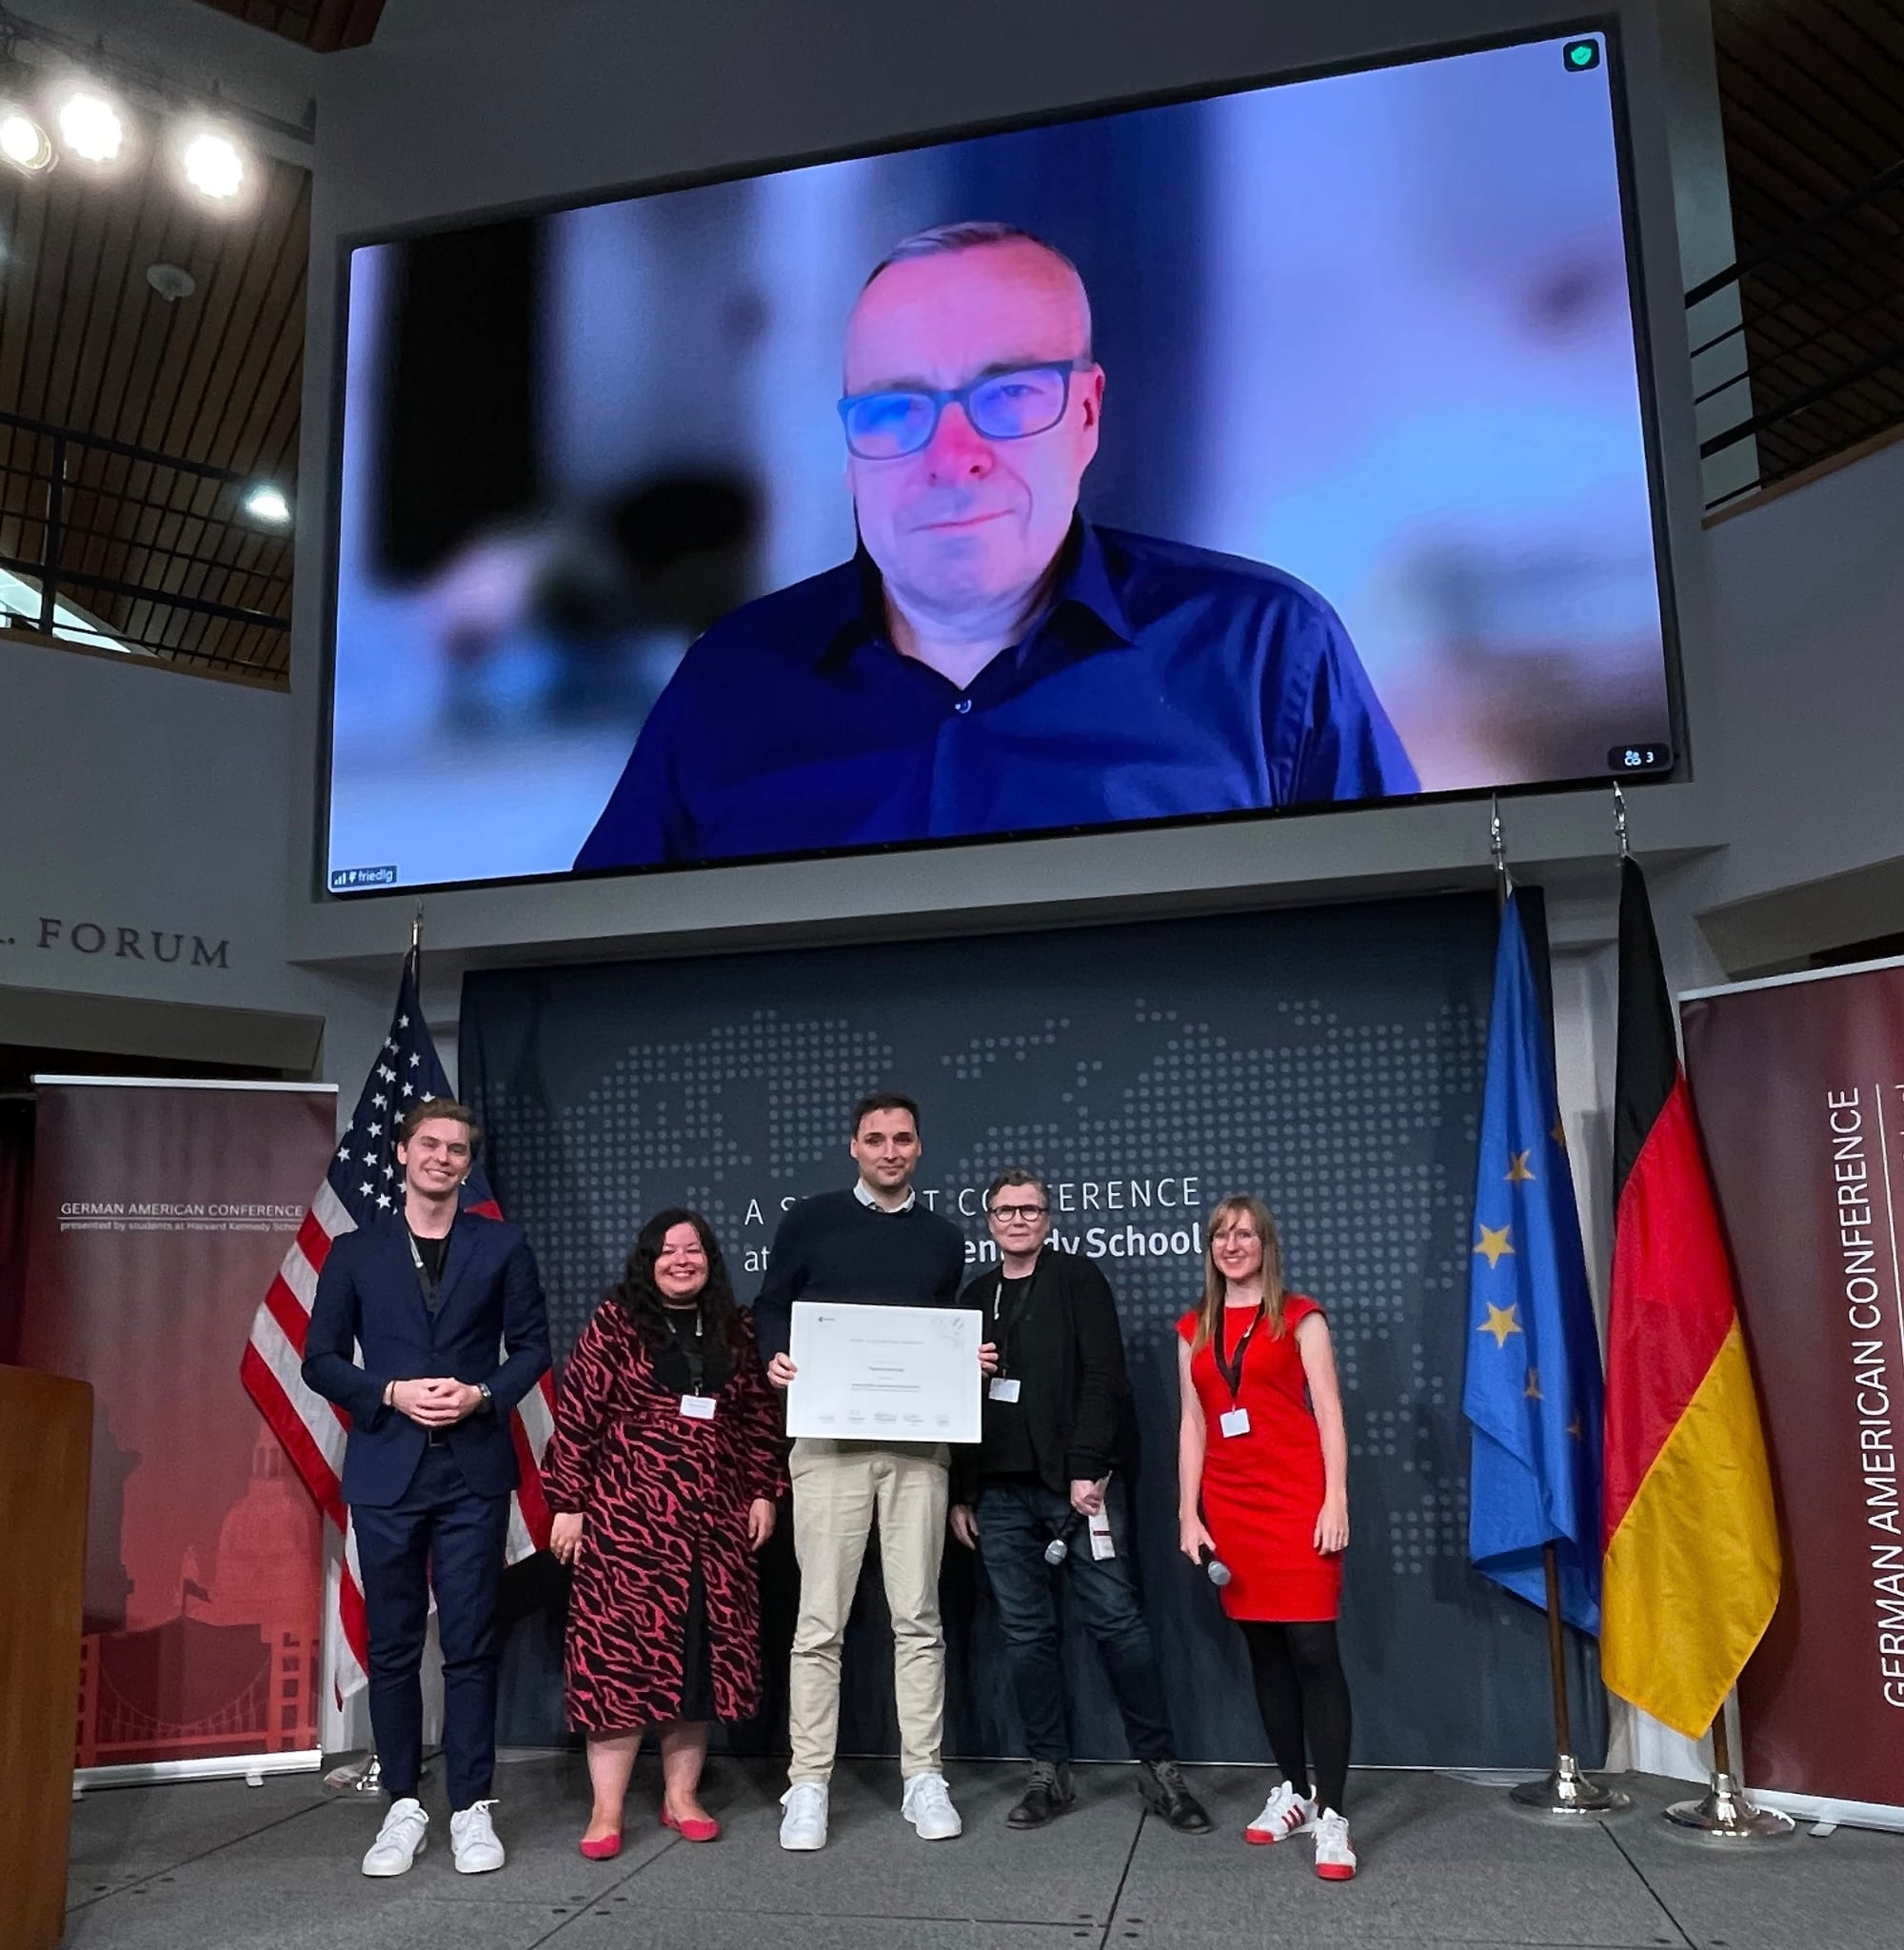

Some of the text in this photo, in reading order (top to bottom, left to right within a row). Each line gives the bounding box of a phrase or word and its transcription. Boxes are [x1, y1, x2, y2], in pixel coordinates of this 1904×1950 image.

[1645, 751, 1655, 764] 3
[36, 917, 230, 969] FORUM
[60, 1203, 304, 1217] GERMAN AMERICAN CONFERENCE
[744, 1198, 764, 1226] A
[958, 1177, 1201, 1217] CERENCE
[1827, 1086, 1881, 1329] CONFERENCE
[744, 1245, 770, 1272] at
[1086, 1222, 1202, 1258] School
[1851, 1341, 1902, 1535] AMERICAN
